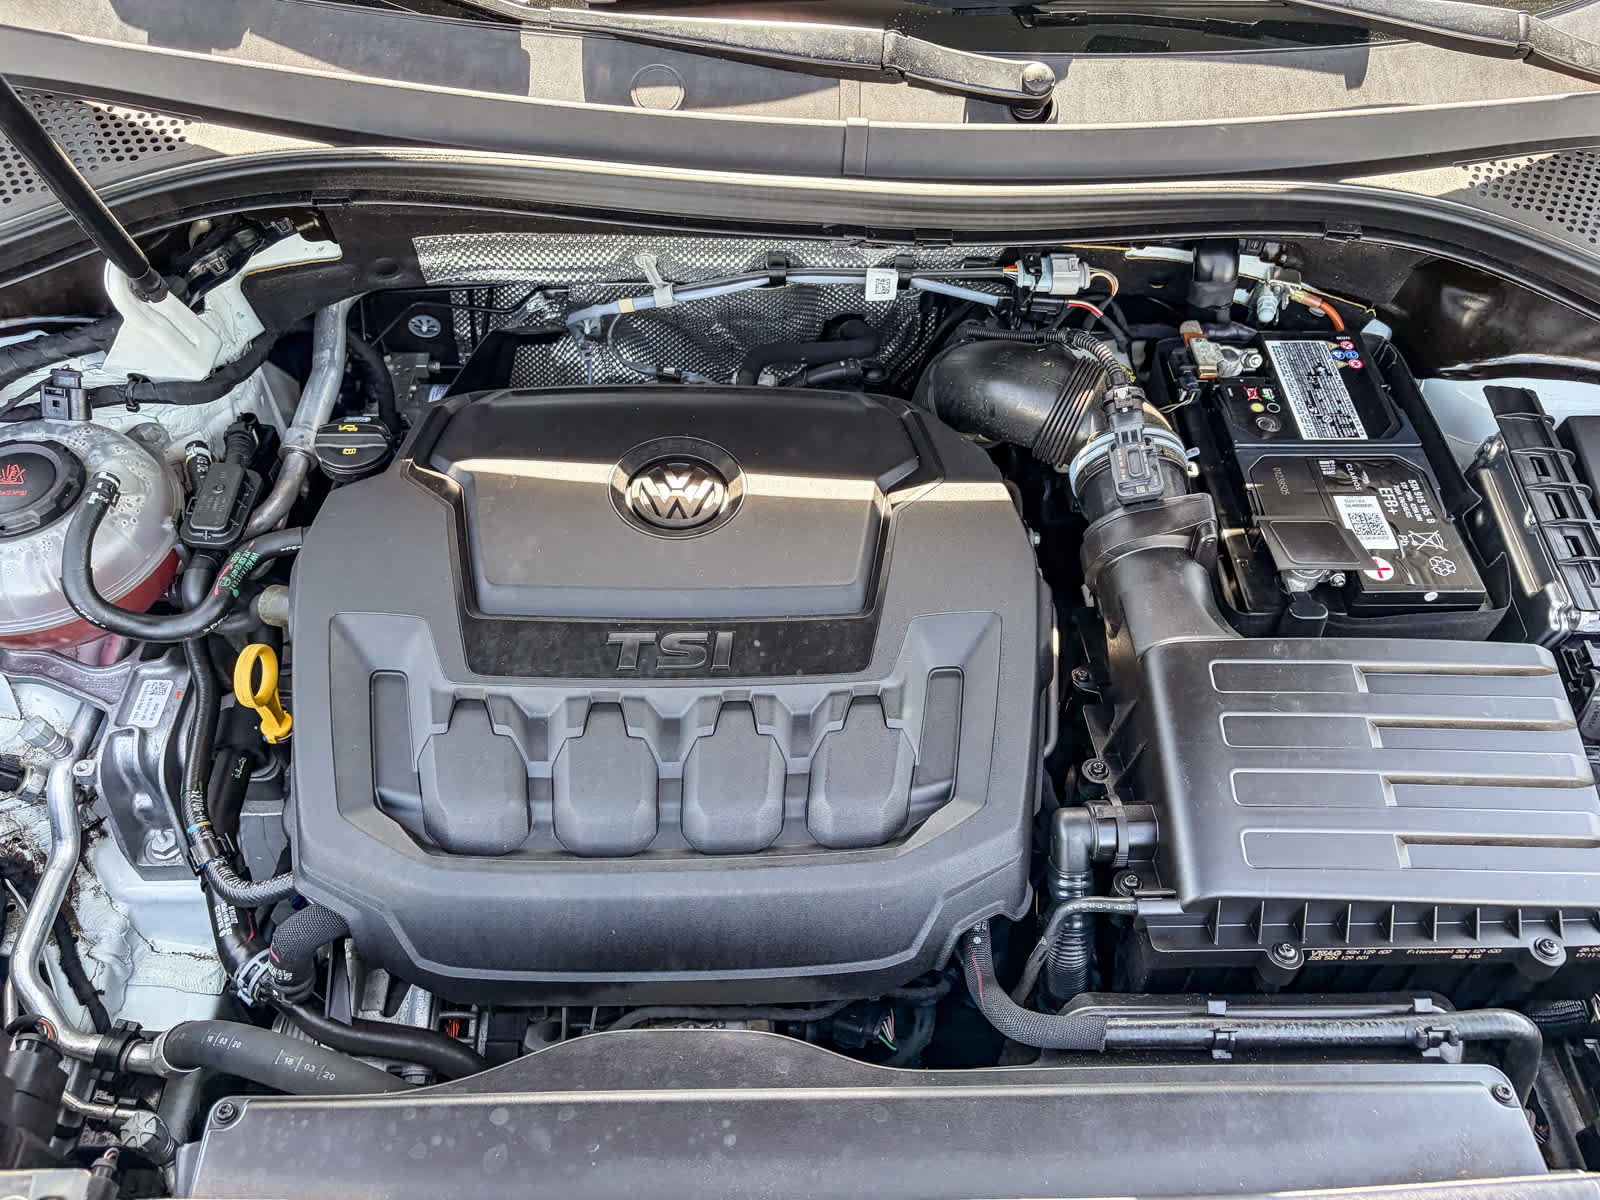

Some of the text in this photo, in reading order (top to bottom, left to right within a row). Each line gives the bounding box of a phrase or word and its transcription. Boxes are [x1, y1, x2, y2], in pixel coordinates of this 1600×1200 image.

[1345, 463, 1362, 491] CLARIOS
[1378, 487, 1399, 516] EFB+
[1413, 491, 1426, 503] 915
[1398, 534, 1410, 546] Pb
[606, 631, 736, 670] TSI
